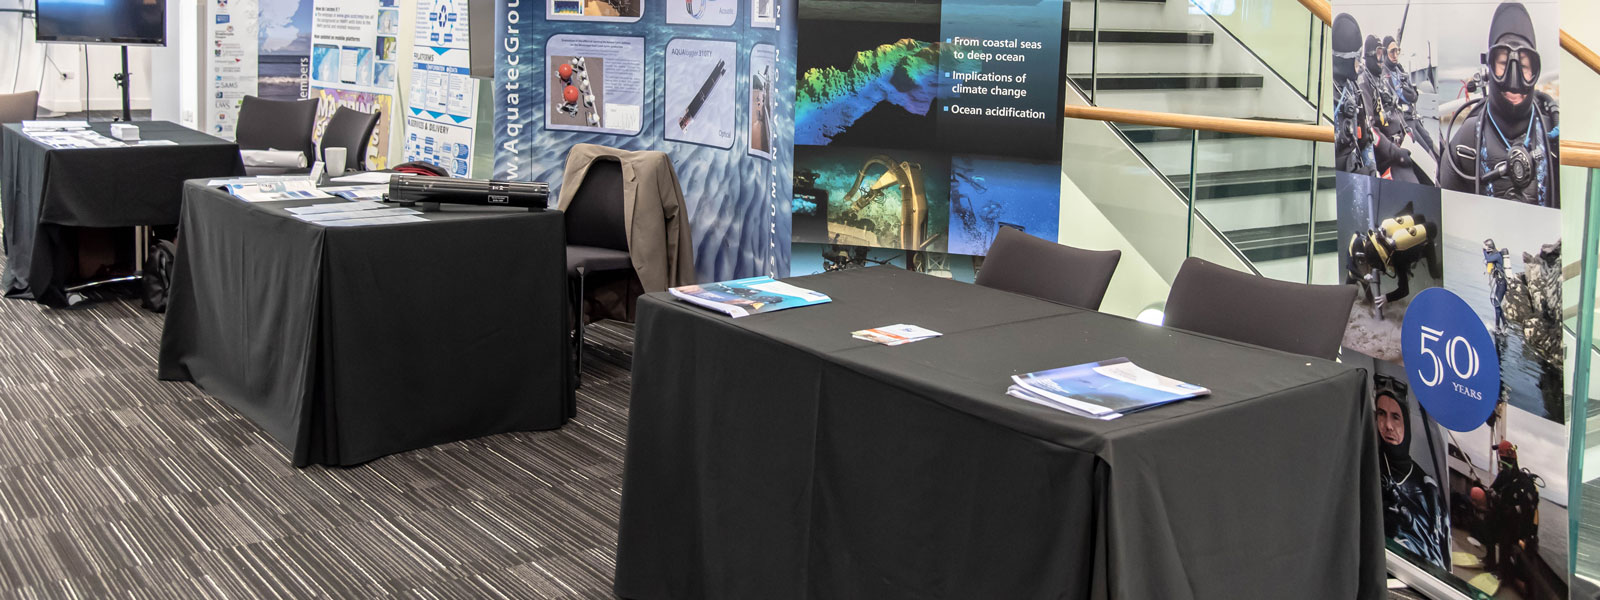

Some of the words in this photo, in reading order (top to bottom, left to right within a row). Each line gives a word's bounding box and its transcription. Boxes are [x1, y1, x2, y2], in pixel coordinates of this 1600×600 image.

[954, 36, 979, 46] From
[982, 38, 1018, 48] coastal
[1020, 40, 1042, 50] seas
[953, 51, 964, 60] to
[967, 50, 993, 62] deep
[995, 52, 1025, 62] ocean
[297, 57, 309, 101] embers
[952, 70, 1013, 82] Implications
[1015, 73, 1027, 83] of
[951, 84, 988, 94] climate
[990, 86, 1027, 98] change
[951, 104, 982, 115] Ocean
[985, 106, 1045, 119] acidification
[1418, 325, 1480, 387] 50
[1452, 382, 1482, 401] YEARS
